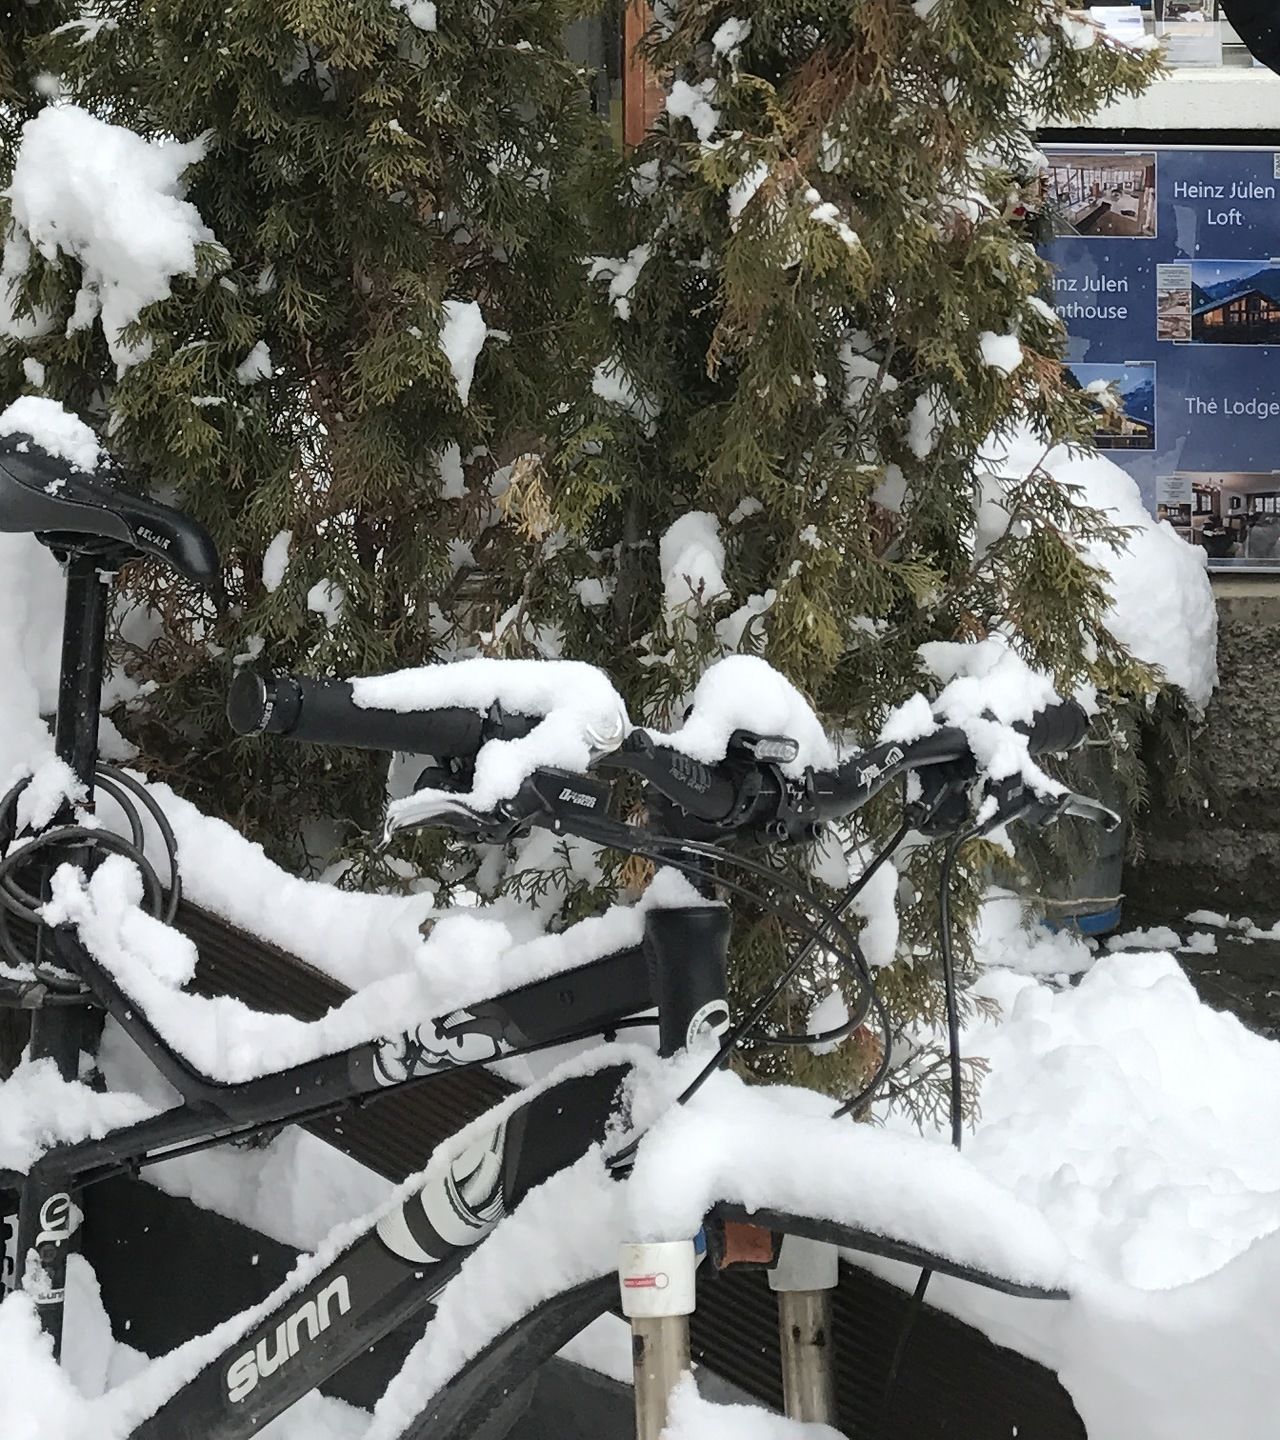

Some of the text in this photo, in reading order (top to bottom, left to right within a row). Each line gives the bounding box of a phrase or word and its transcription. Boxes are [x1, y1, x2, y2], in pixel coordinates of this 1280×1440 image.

[1174, 181, 1275, 199] Heinz Julen
[1207, 208, 1242, 225] Loft
[1081, 275, 1128, 292] Julen
[1184, 397, 1280, 420] The Lodge
[227, 1275, 351, 1403] sunn
